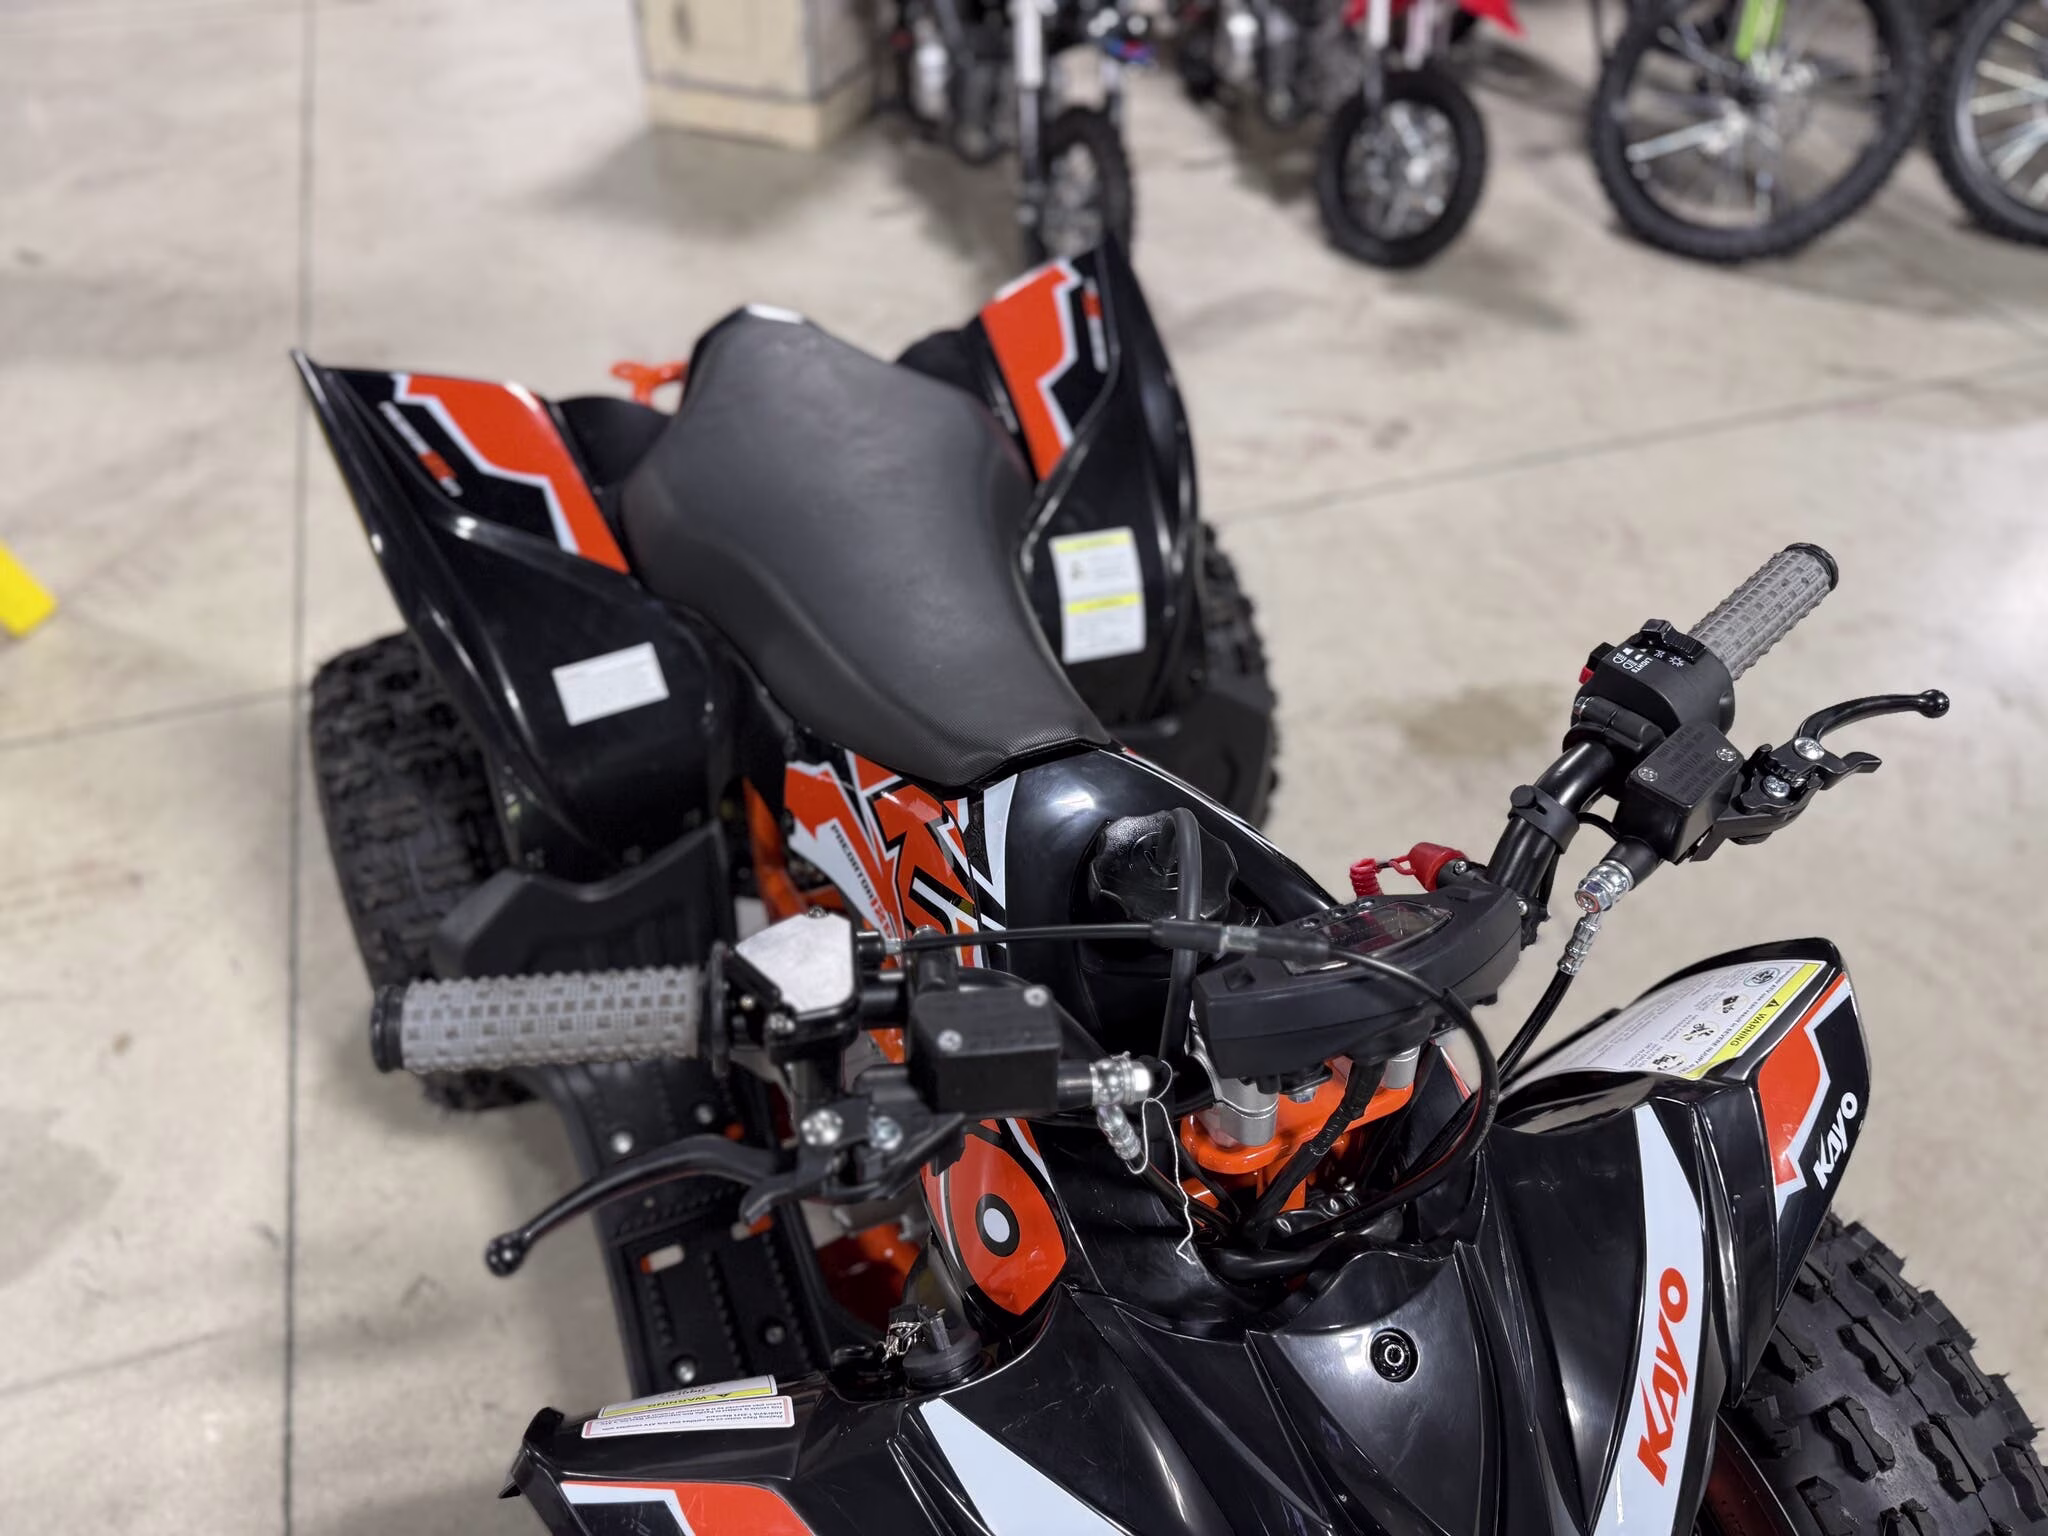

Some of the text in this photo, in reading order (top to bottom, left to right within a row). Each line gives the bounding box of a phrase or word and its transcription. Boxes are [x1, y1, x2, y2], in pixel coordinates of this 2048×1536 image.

[1630, 657, 1653, 673] LIGHTS
[1713, 1026, 1732, 1047] SEVERE
[1729, 1013, 1767, 1047] WARNING
[1695, 1046, 1714, 1064] INJURY
[1812, 1092, 1858, 1190] KAYO
[1636, 1267, 1689, 1488] KAYO
